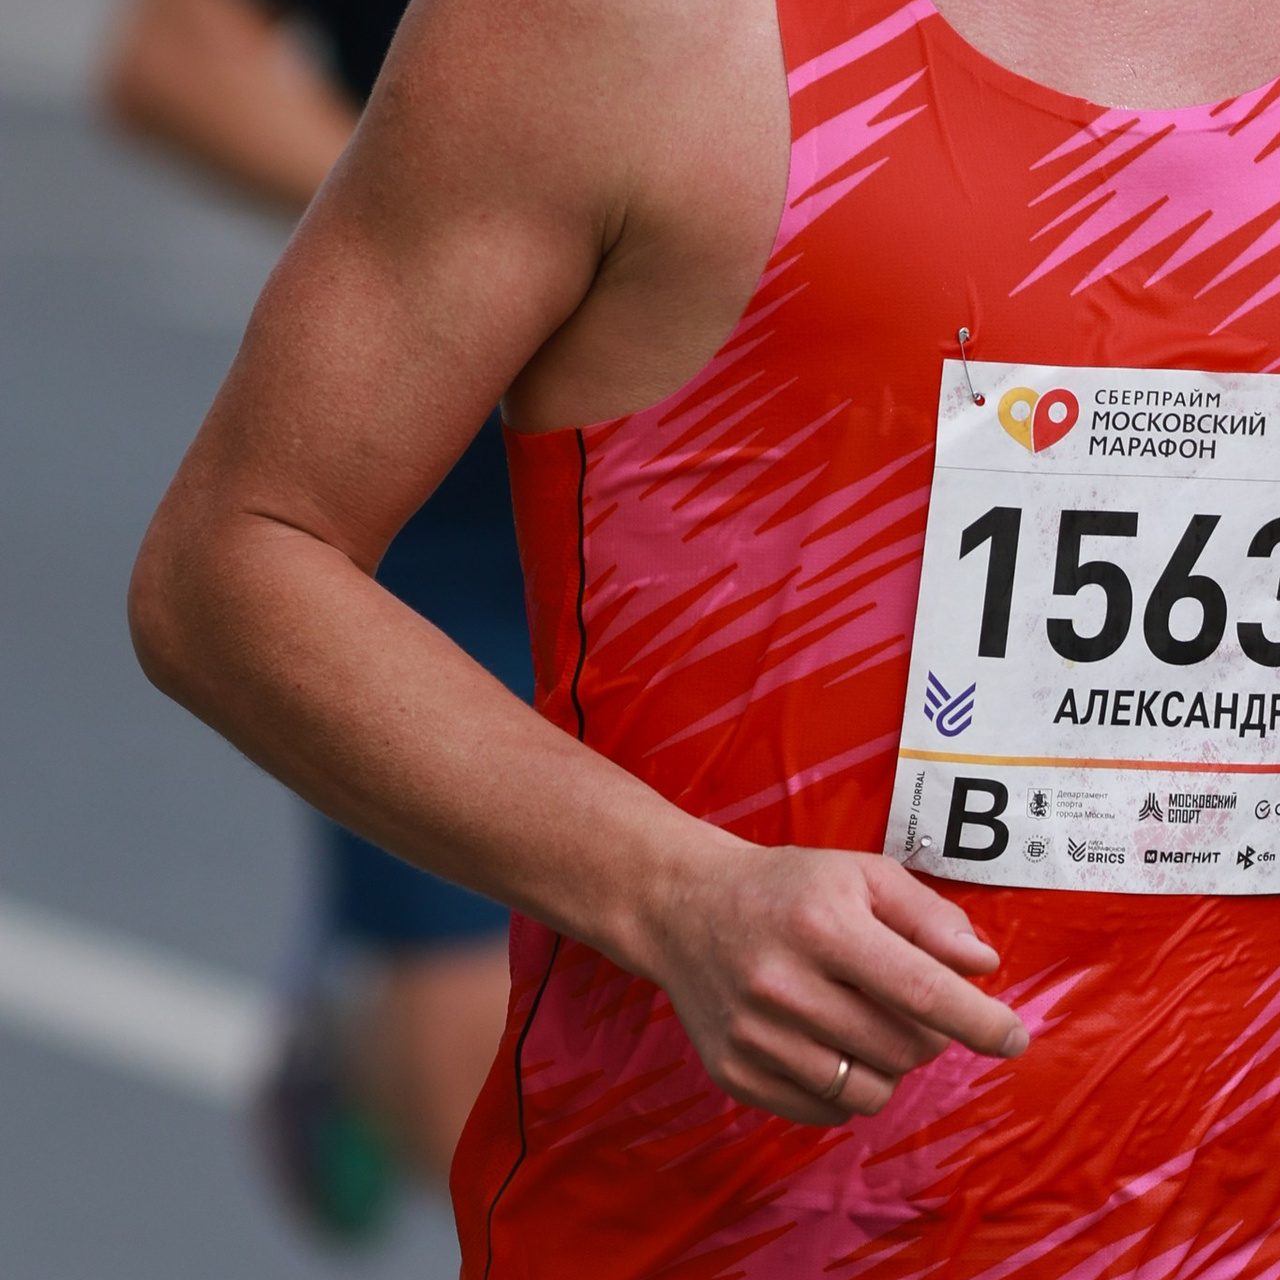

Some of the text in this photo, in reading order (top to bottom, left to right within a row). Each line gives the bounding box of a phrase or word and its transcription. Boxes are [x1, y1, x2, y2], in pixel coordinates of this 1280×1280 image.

[1094, 388, 1222, 408] СБЕРПРАЙМ
[1091, 411, 1267, 437] МОСКОВСКИЙ
[1088, 435, 1217, 460] МАРАФОН
[1056, 790, 1108, 800] Департамент
[1168, 792, 1238, 809] МОСКОВСКИЙ
[904, 813, 920, 852] КЛАСТЕР
[912, 771, 926, 806] CORRAL
[1056, 801, 1083, 809] спорта
[1056, 811, 1116, 819] города Москвы
[1168, 808, 1202, 824] СПОРТ
[1087, 852, 1125, 864] BRICS
[1257, 851, 1276, 862] сбп
